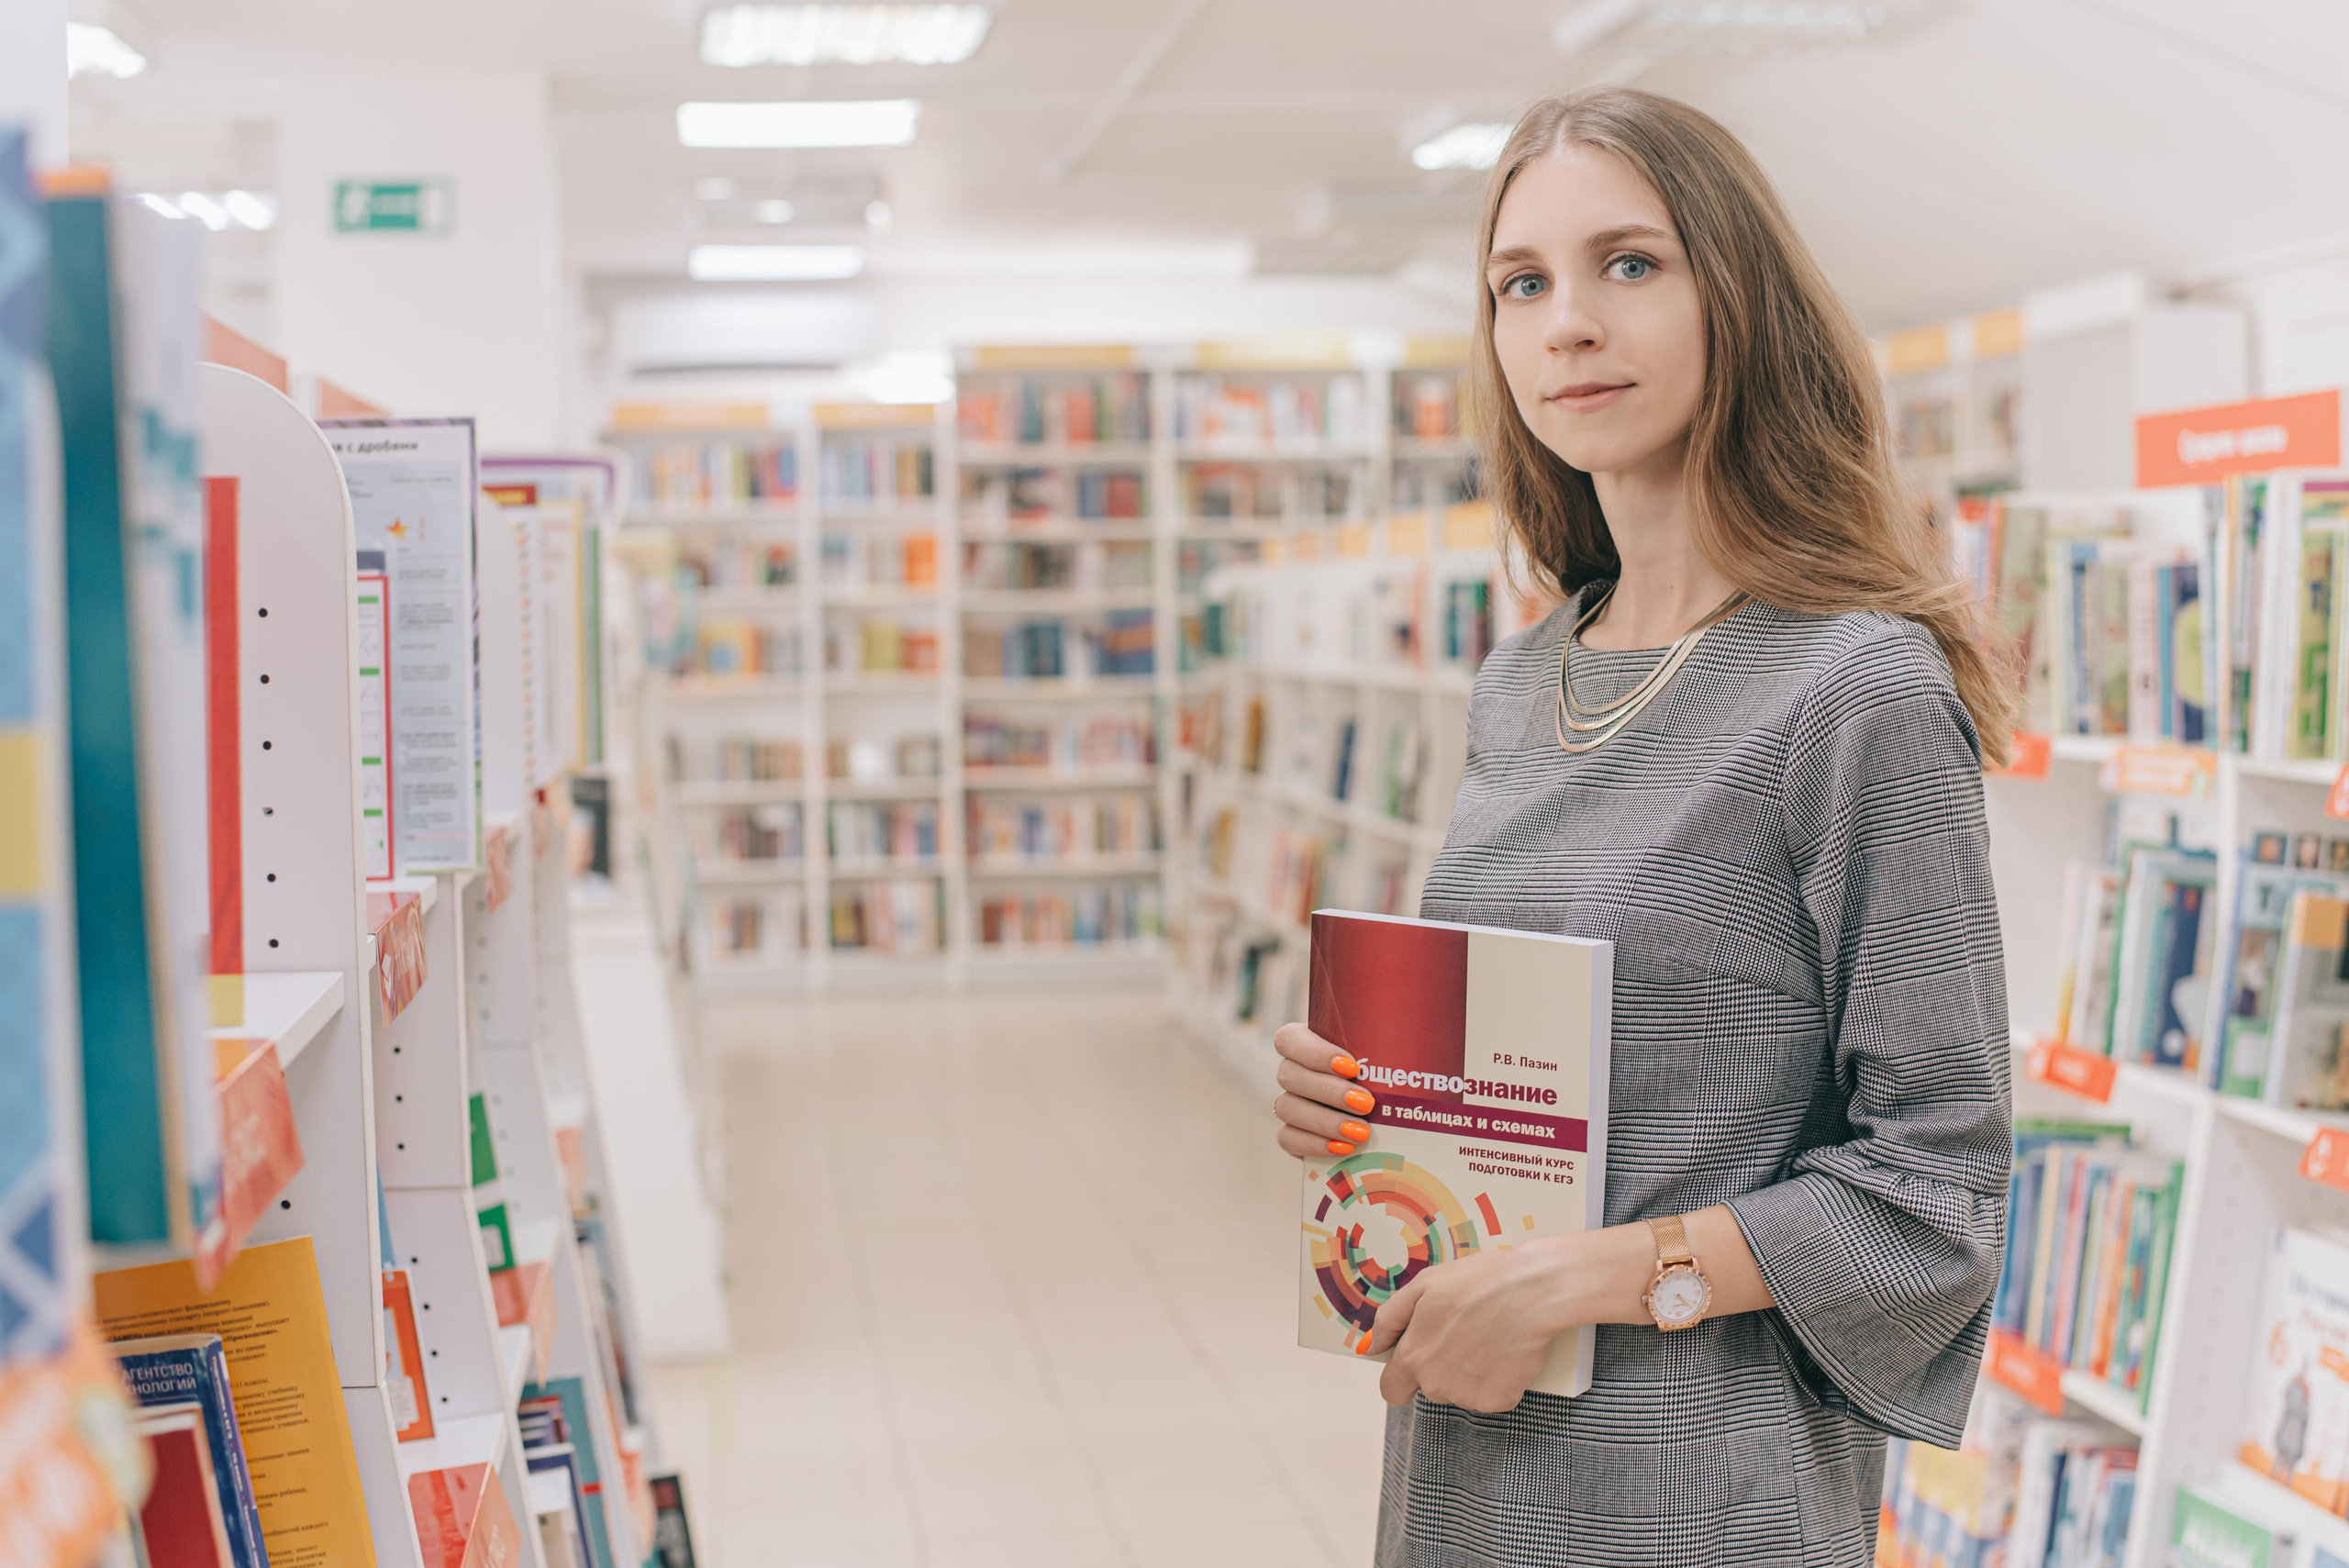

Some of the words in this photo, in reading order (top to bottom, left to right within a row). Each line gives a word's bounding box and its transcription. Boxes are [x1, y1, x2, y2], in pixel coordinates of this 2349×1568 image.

[358, 439, 418, 453] дробями
[1493, 1053, 1516, 1066] Р.В.
[1520, 1056, 1558, 1072] Пазин
[1356, 1058, 1558, 1106] бществознание
[1382, 1105, 1392, 1117] в
[1396, 1105, 1473, 1128] таблицах
[1477, 1118, 1487, 1129] и
[1491, 1119, 1555, 1139] схемах
[1459, 1146, 1542, 1166] ИНТЕНСИВНЫЙ
[1546, 1159, 1575, 1171] КУРС
[1468, 1162, 1541, 1181] ПОДГОТОВКИ
[1543, 1173, 1551, 1182] К
[1553, 1174, 1575, 1185] ЕГЭ
